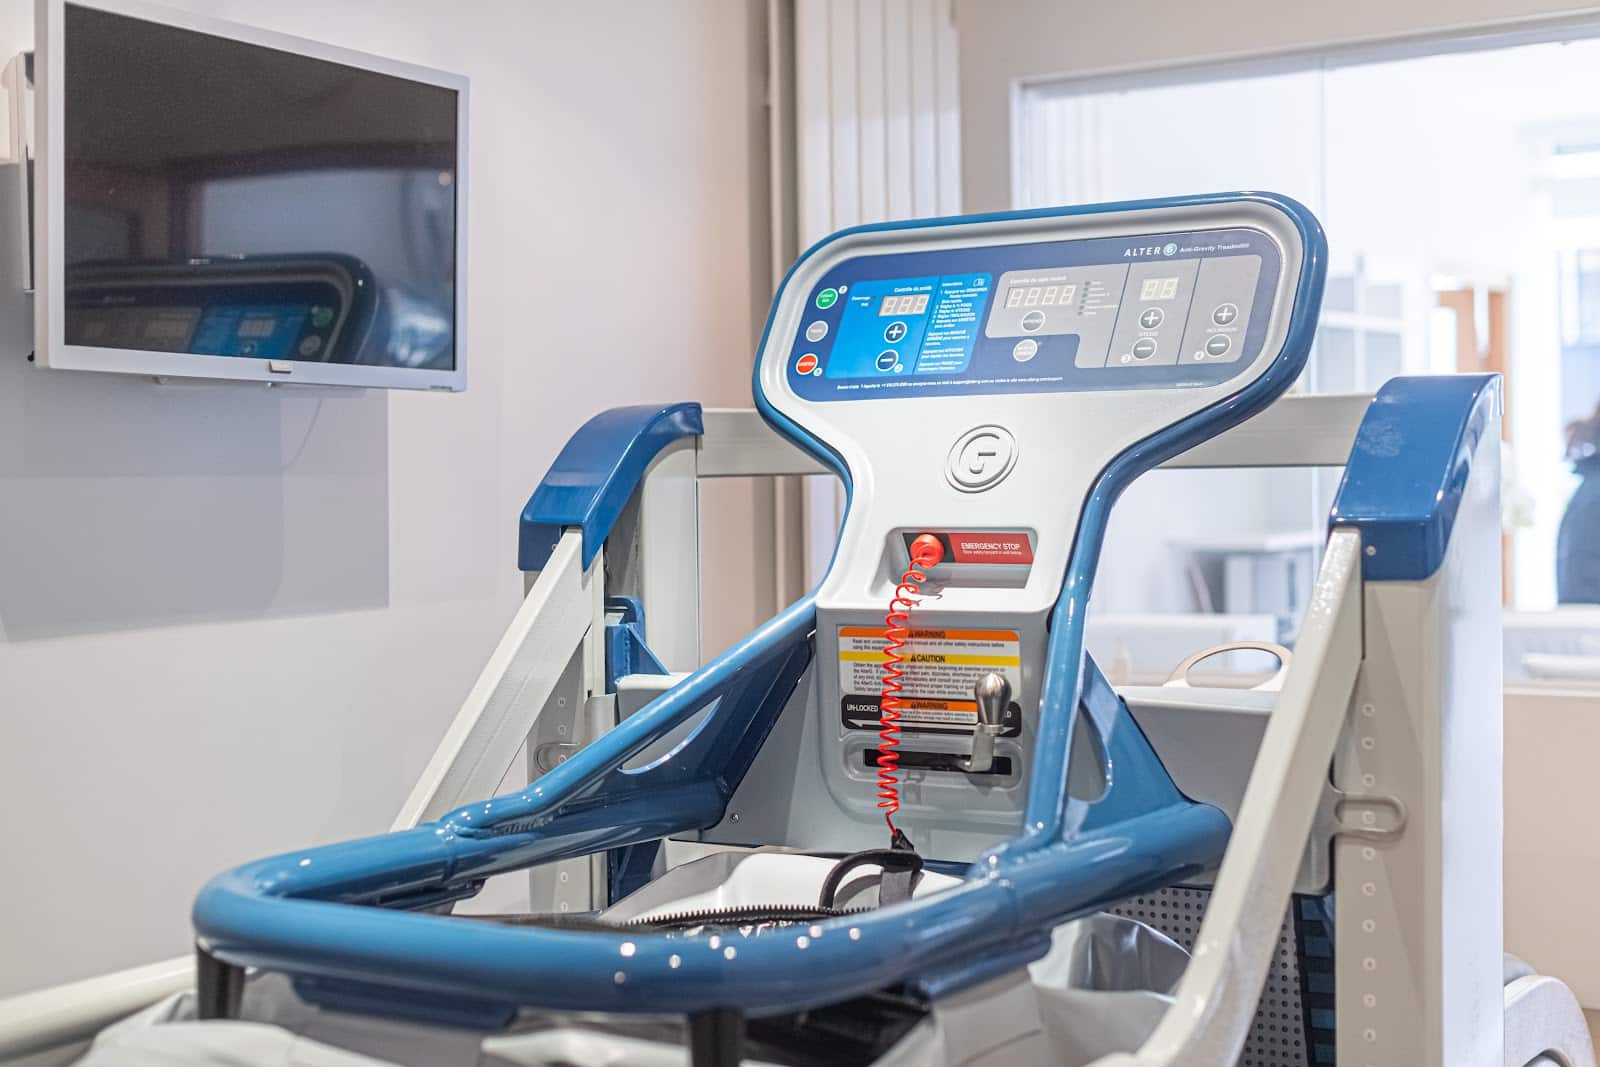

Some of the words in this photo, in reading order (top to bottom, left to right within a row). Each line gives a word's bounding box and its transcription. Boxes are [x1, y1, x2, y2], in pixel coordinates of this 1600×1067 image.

[961, 542, 1001, 551] EMERGENCY
[1002, 543, 1021, 552] STOP
[914, 630, 945, 638] WARNING
[917, 654, 945, 662] CAUTION
[846, 703, 879, 713] UN-LOCKED
